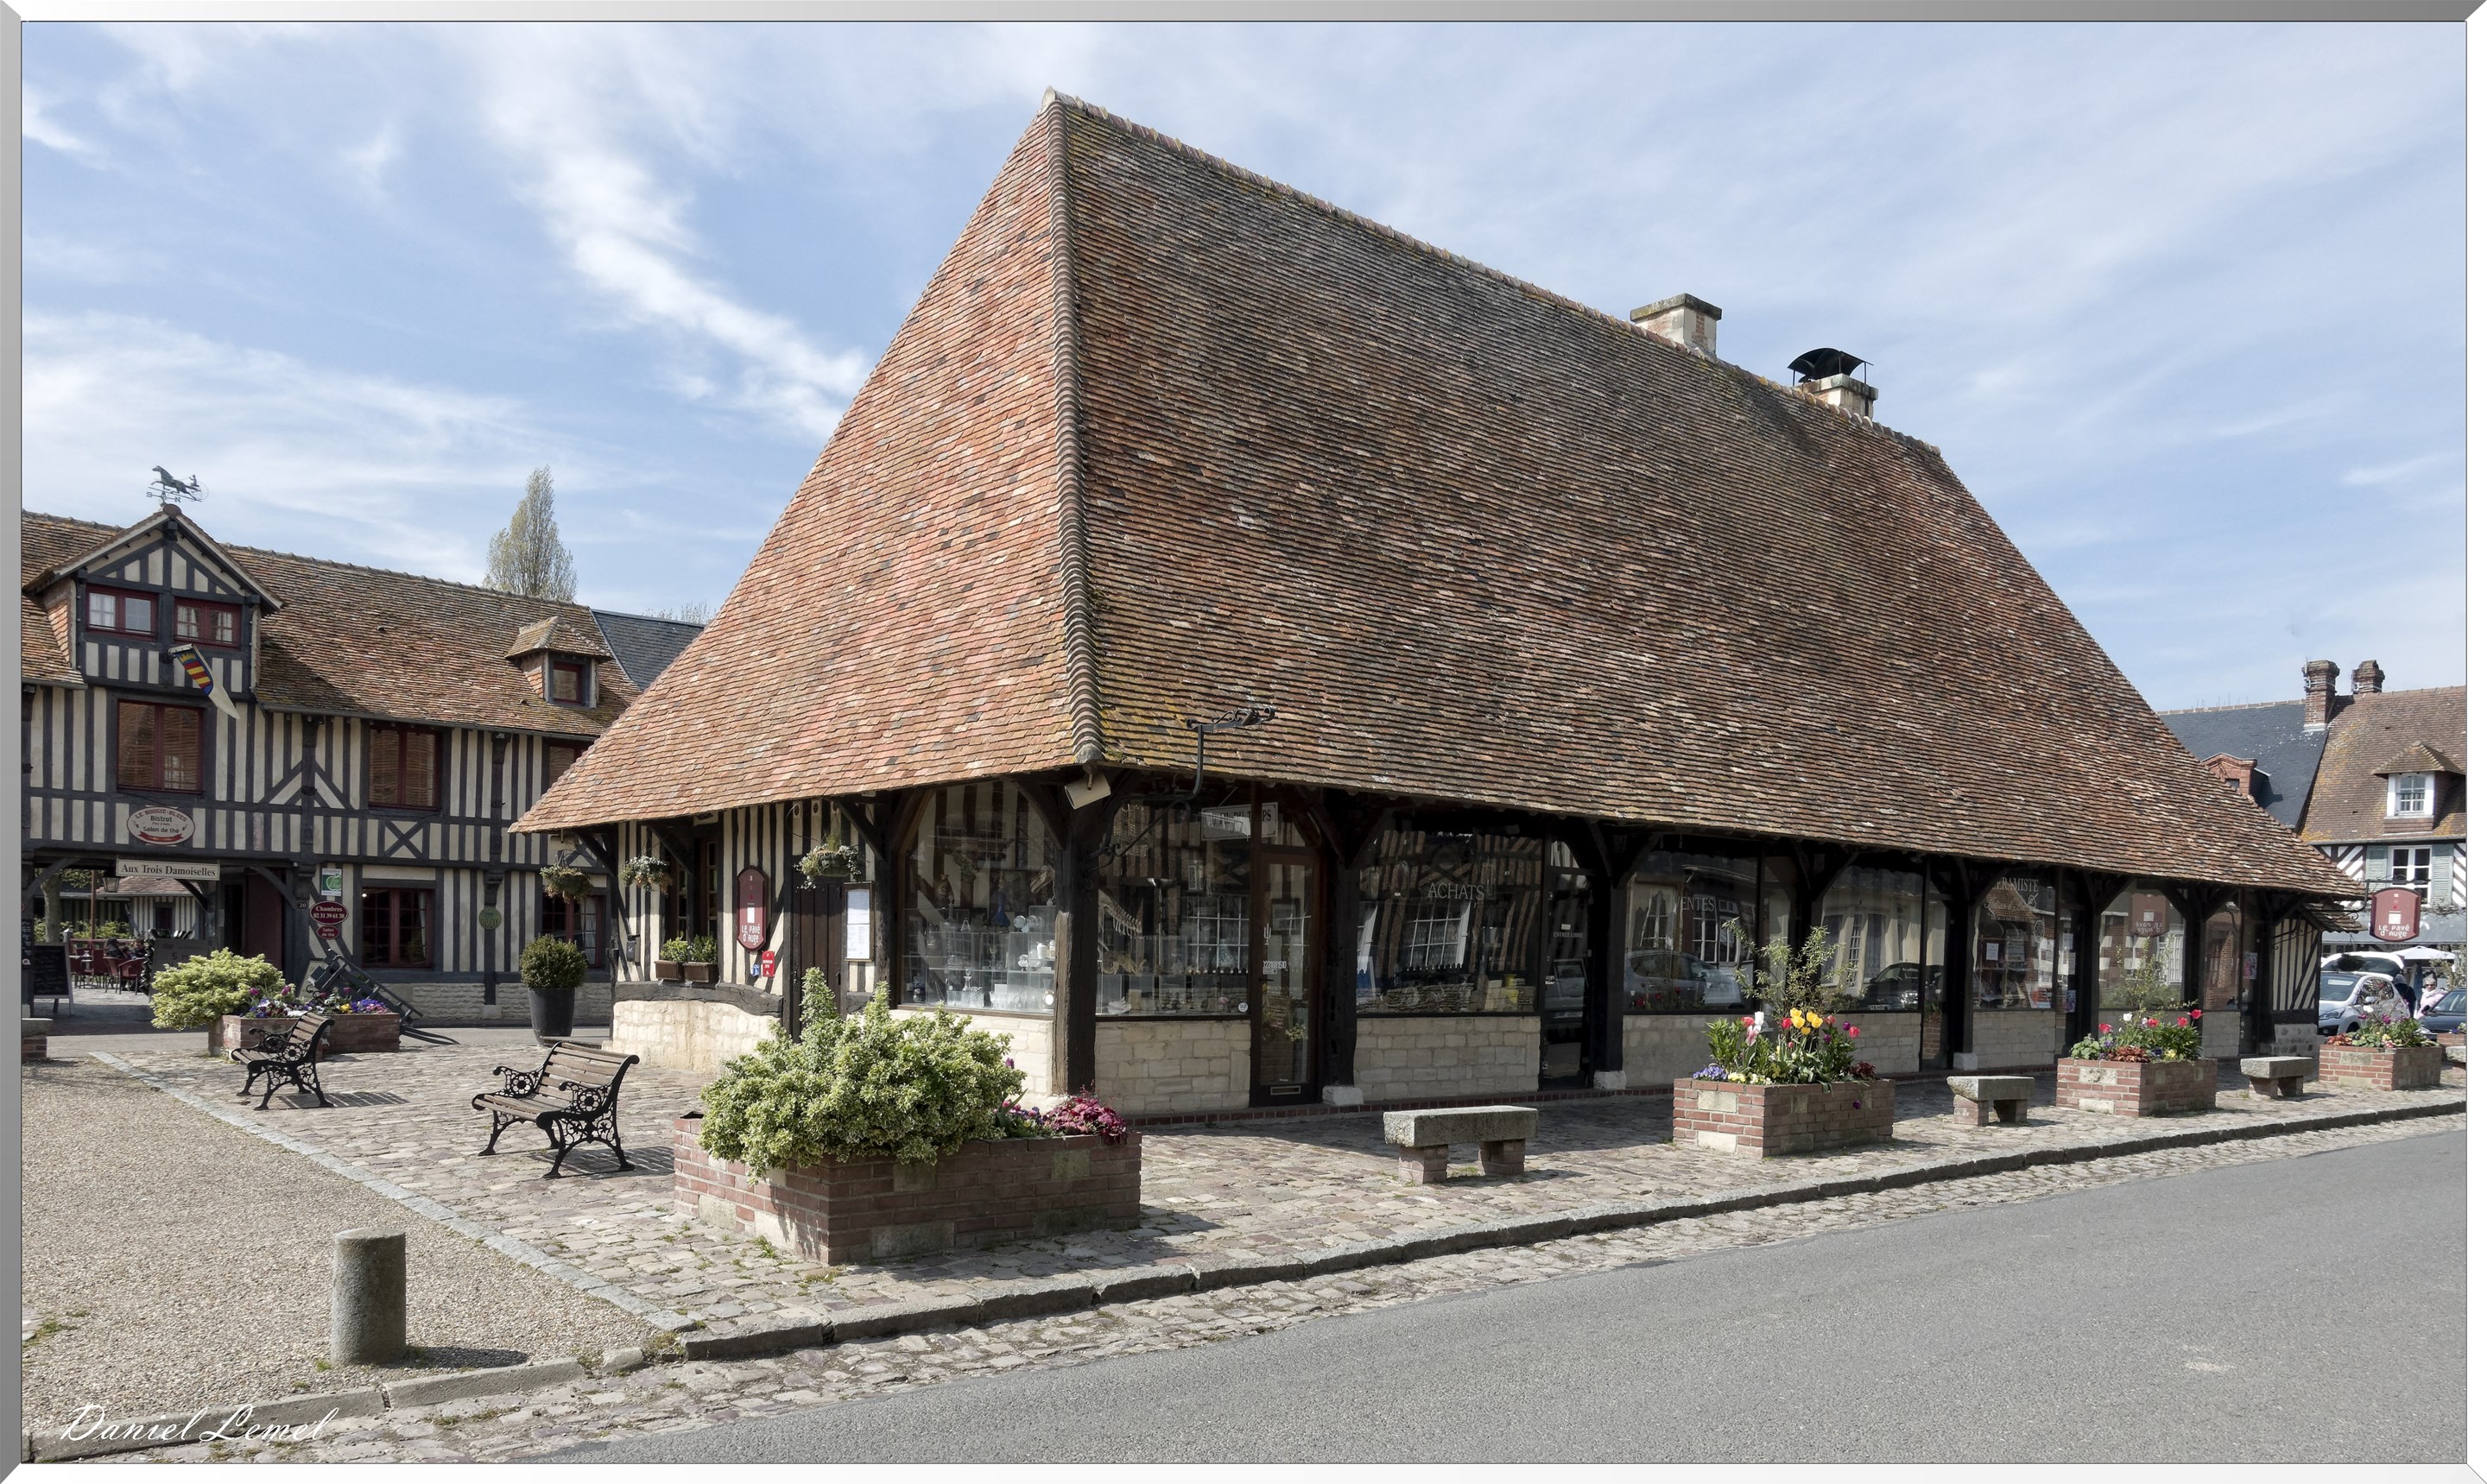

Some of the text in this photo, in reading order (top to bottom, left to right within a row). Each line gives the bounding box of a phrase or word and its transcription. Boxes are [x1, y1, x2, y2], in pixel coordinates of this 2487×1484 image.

[121, 864, 216, 876] Aux Trois Damoiselles
[1427, 881, 1484, 900] ACHATS
